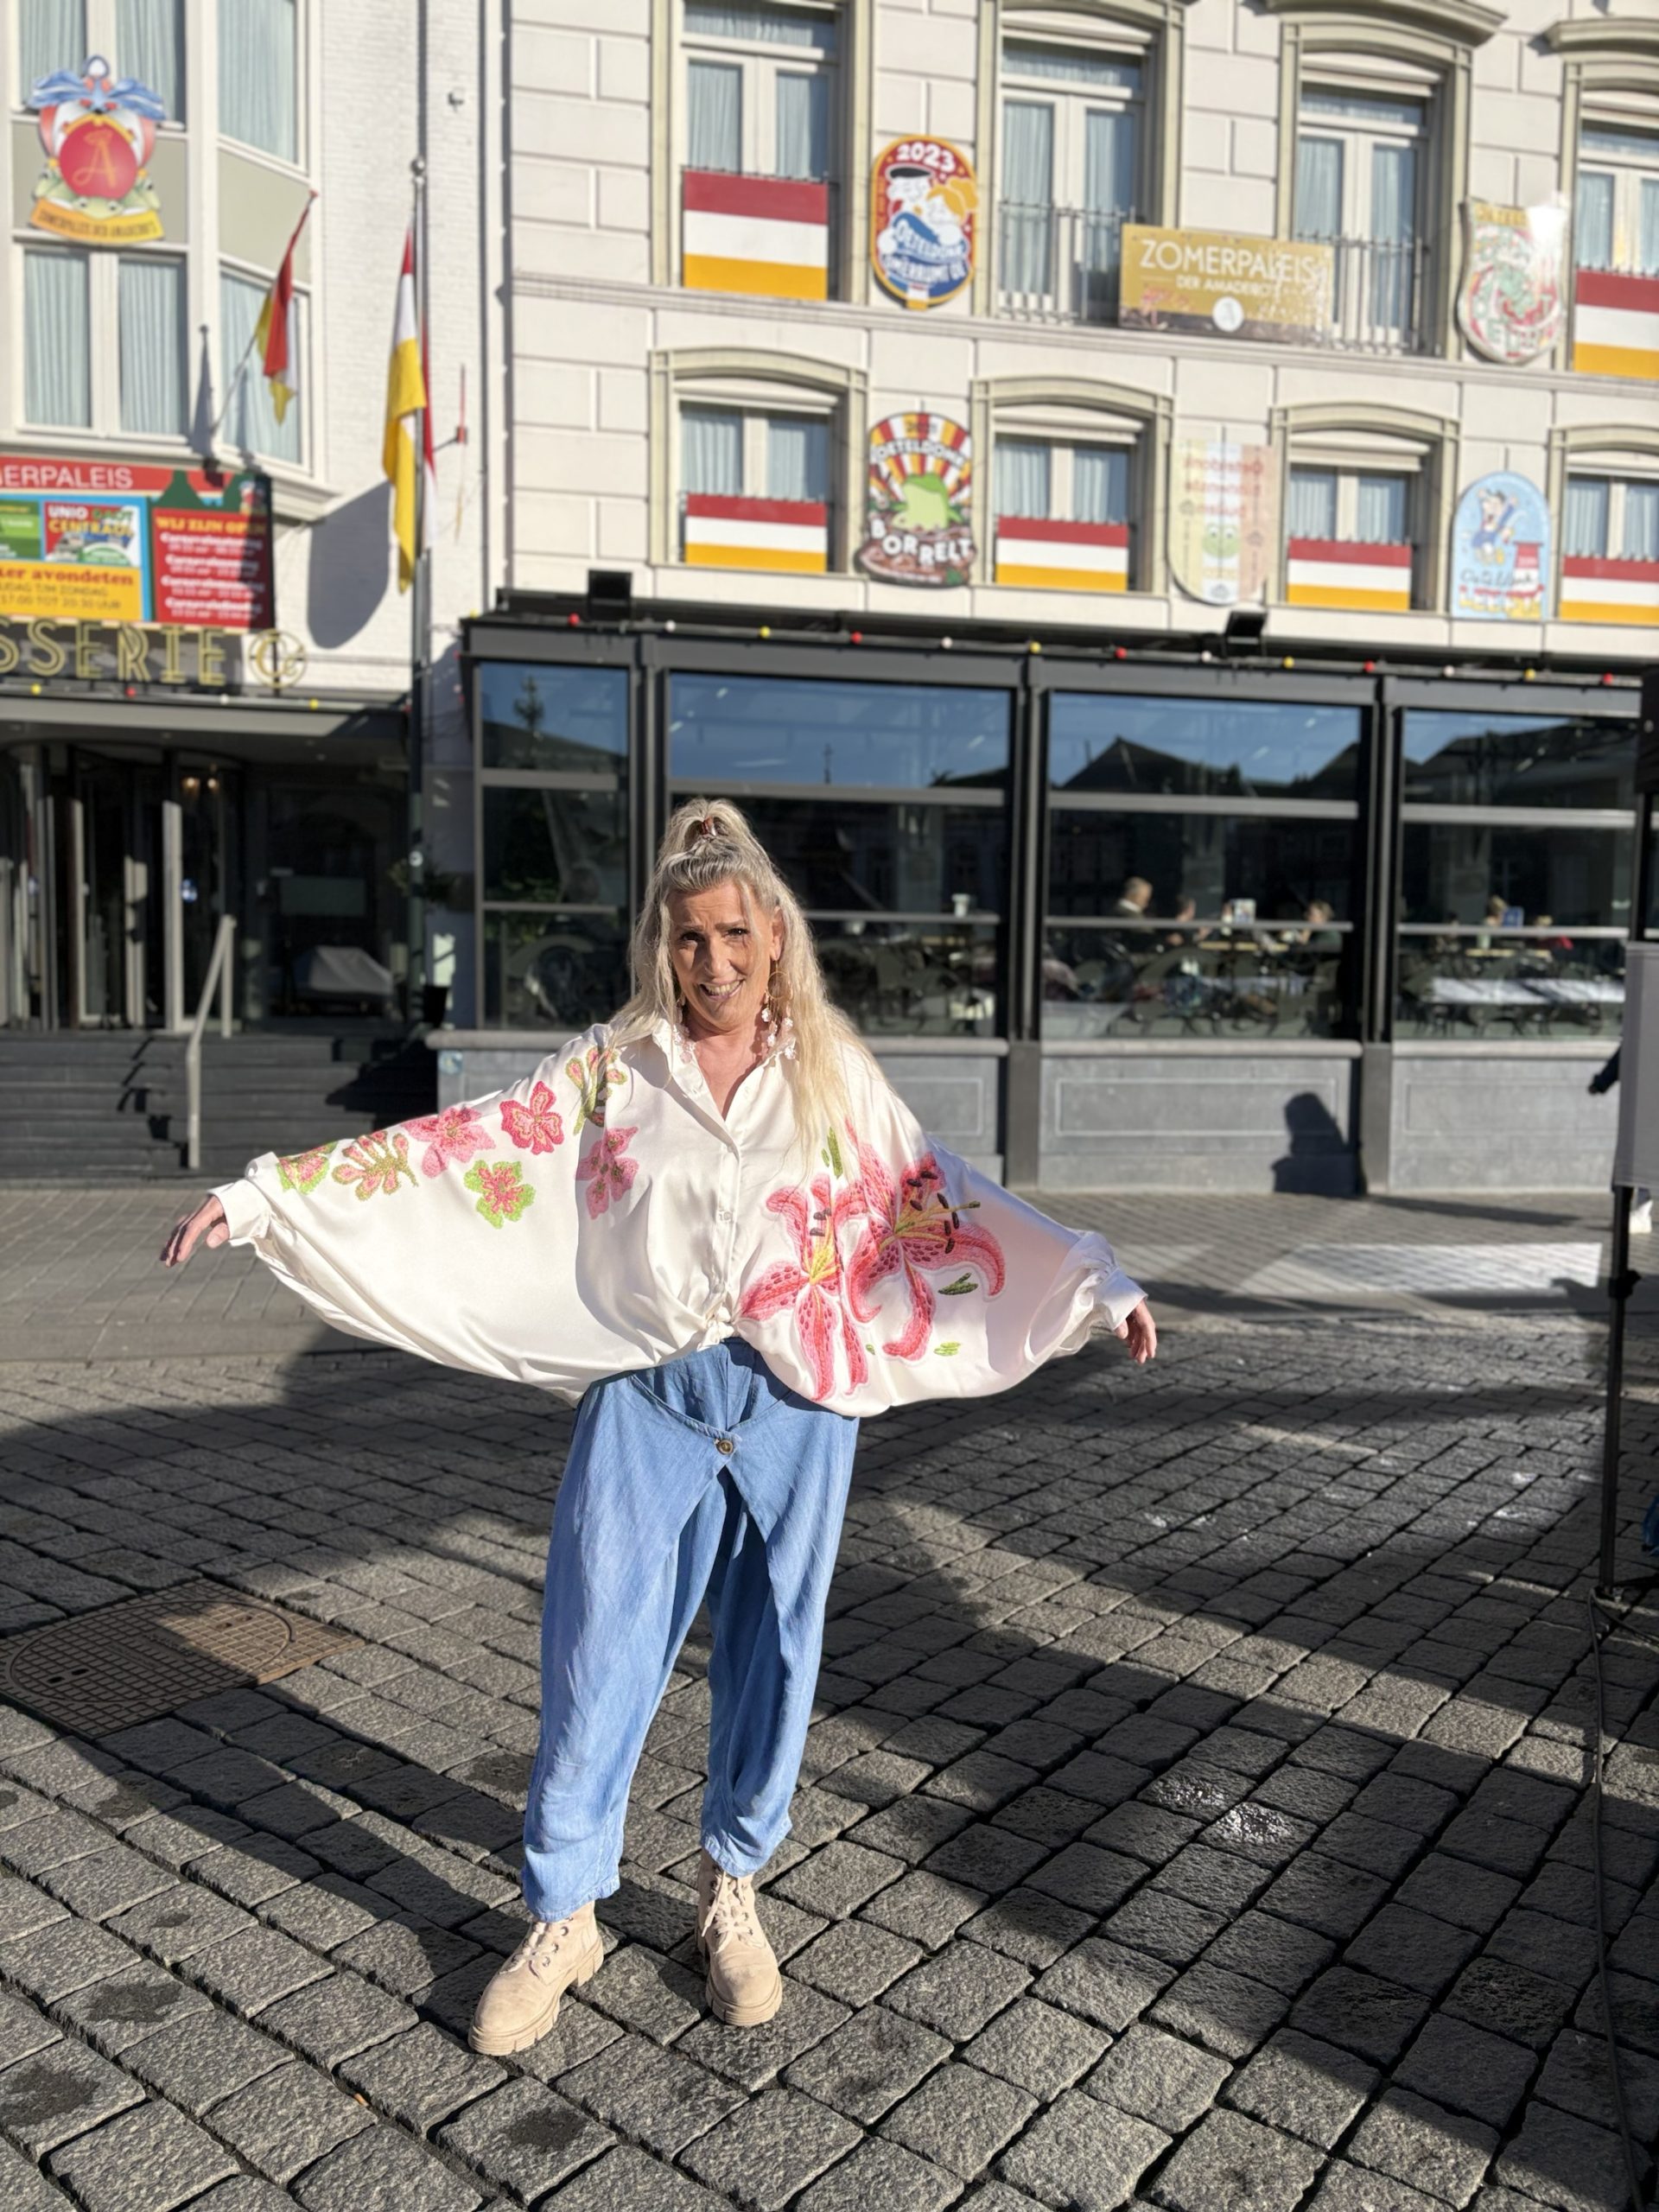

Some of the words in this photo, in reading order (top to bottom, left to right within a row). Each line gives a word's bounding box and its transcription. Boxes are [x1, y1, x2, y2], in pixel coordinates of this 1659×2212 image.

[896, 142, 956, 173] 2023
[1140, 239, 1315, 283] ZOMERPALEIS
[0, 465, 133, 489] ERPALEIS
[871, 518, 971, 567] BORRELT
[32, 569, 133, 585] avondeten
